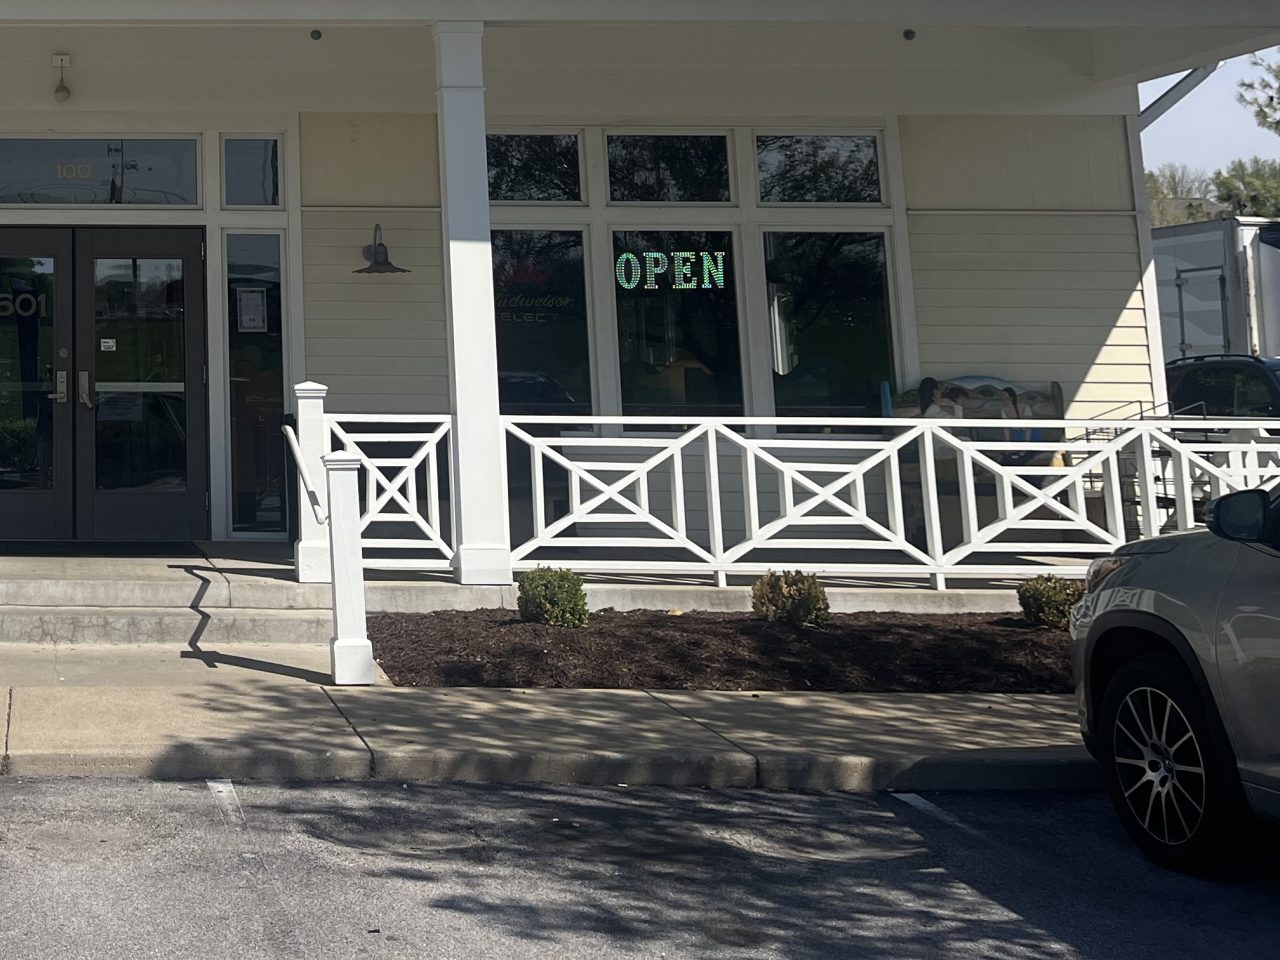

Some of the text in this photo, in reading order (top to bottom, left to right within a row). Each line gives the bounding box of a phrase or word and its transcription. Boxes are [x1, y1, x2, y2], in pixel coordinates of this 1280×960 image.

[56, 163, 91, 179] 100
[616, 251, 726, 290] OPEN
[496, 312, 558, 322] ELECT
